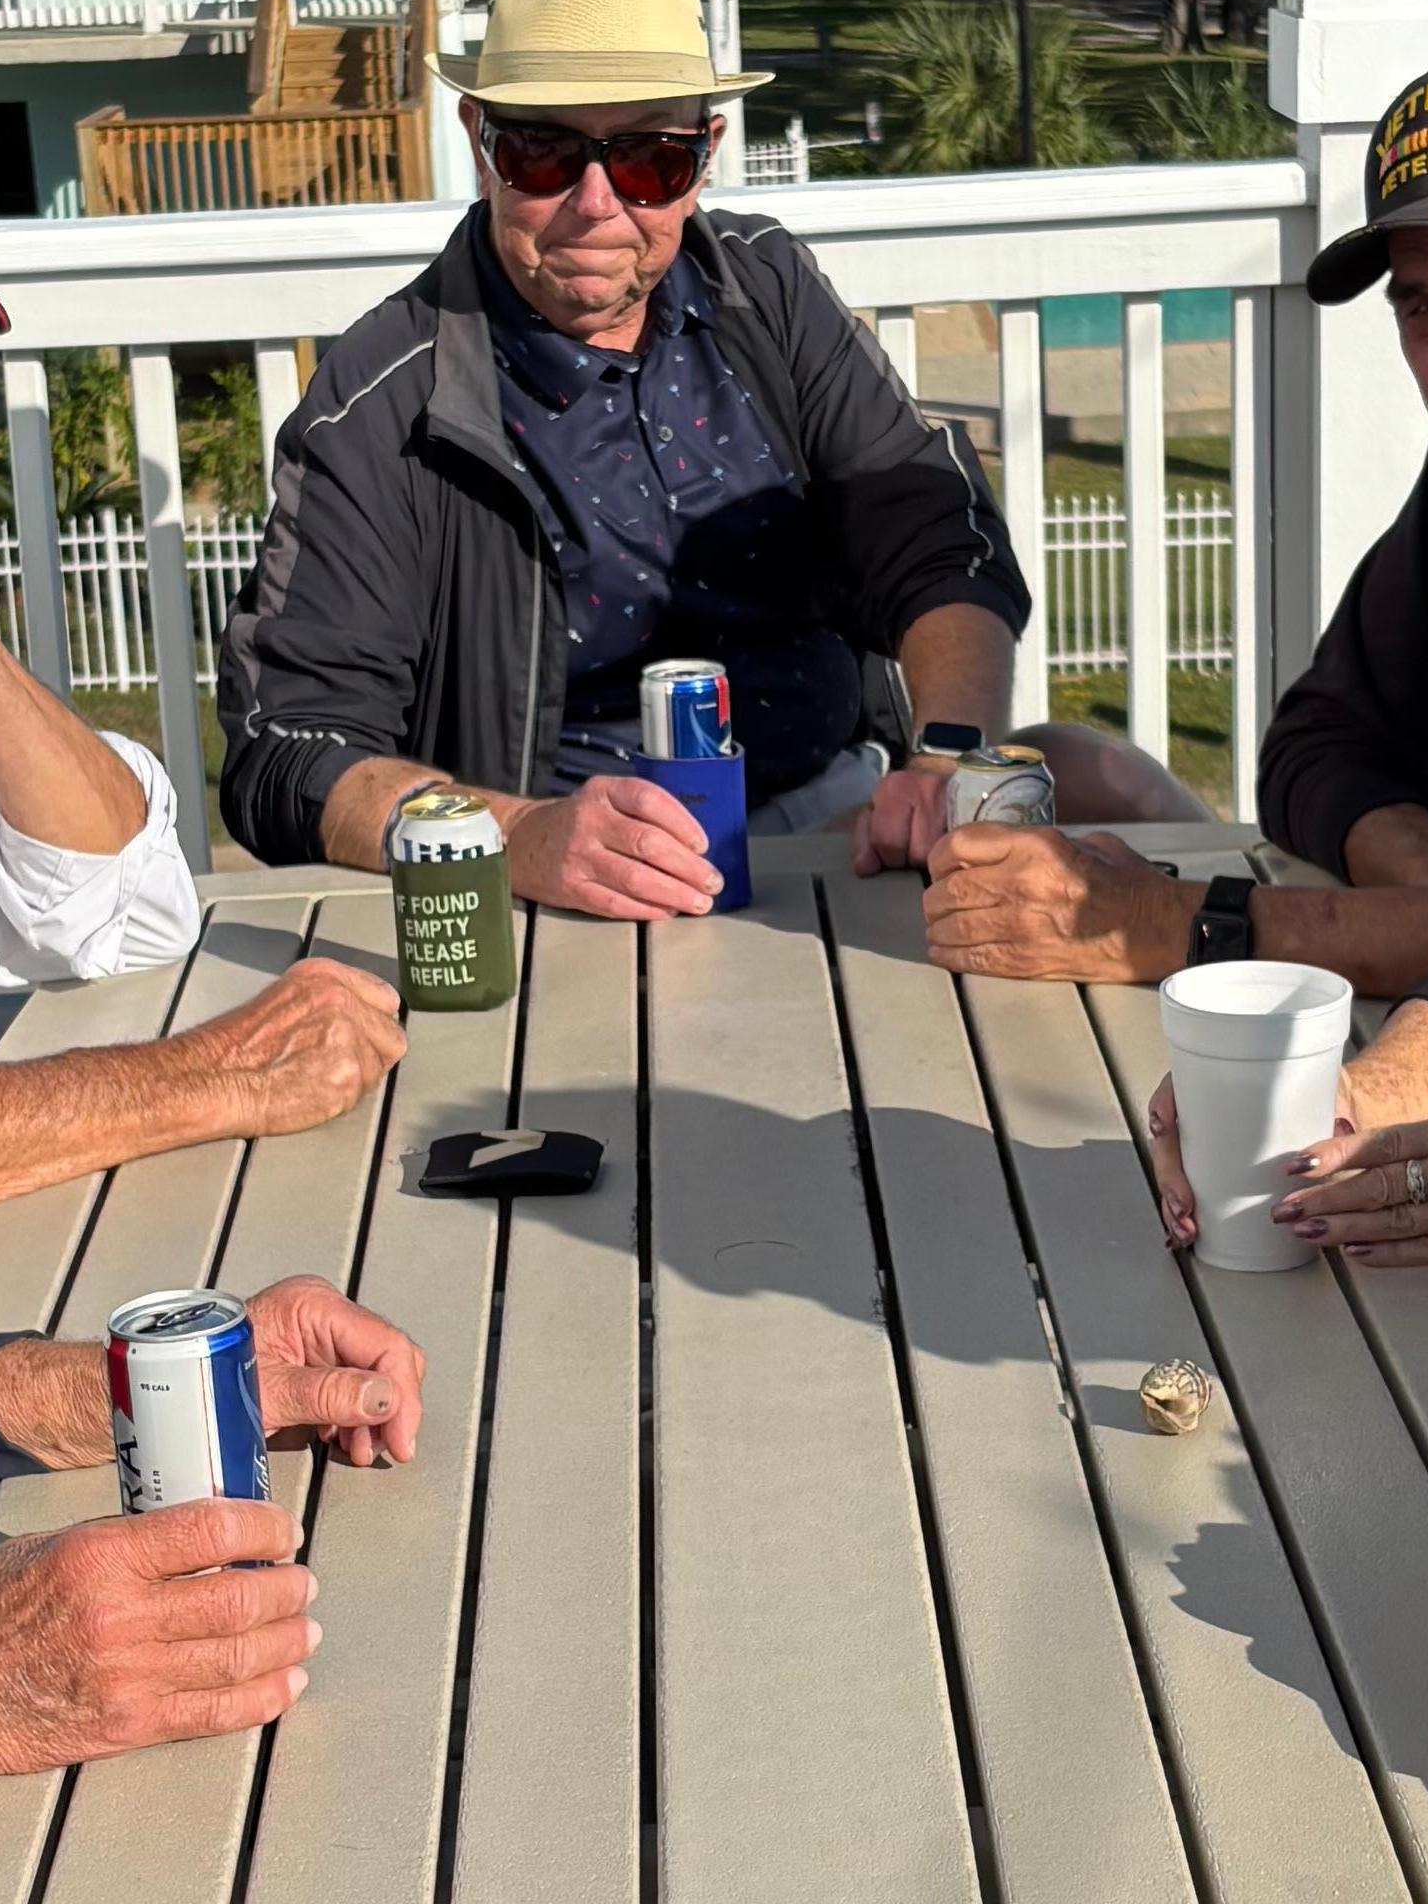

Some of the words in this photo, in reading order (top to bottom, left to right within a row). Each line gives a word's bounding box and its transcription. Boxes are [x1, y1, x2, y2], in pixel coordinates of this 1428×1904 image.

[395, 895, 406, 913] IF
[411, 891, 480, 915] FOUND
[405, 916, 469, 939] EMPTY
[405, 939, 478, 963] PLEASE
[410, 964, 476, 987] REFILL
